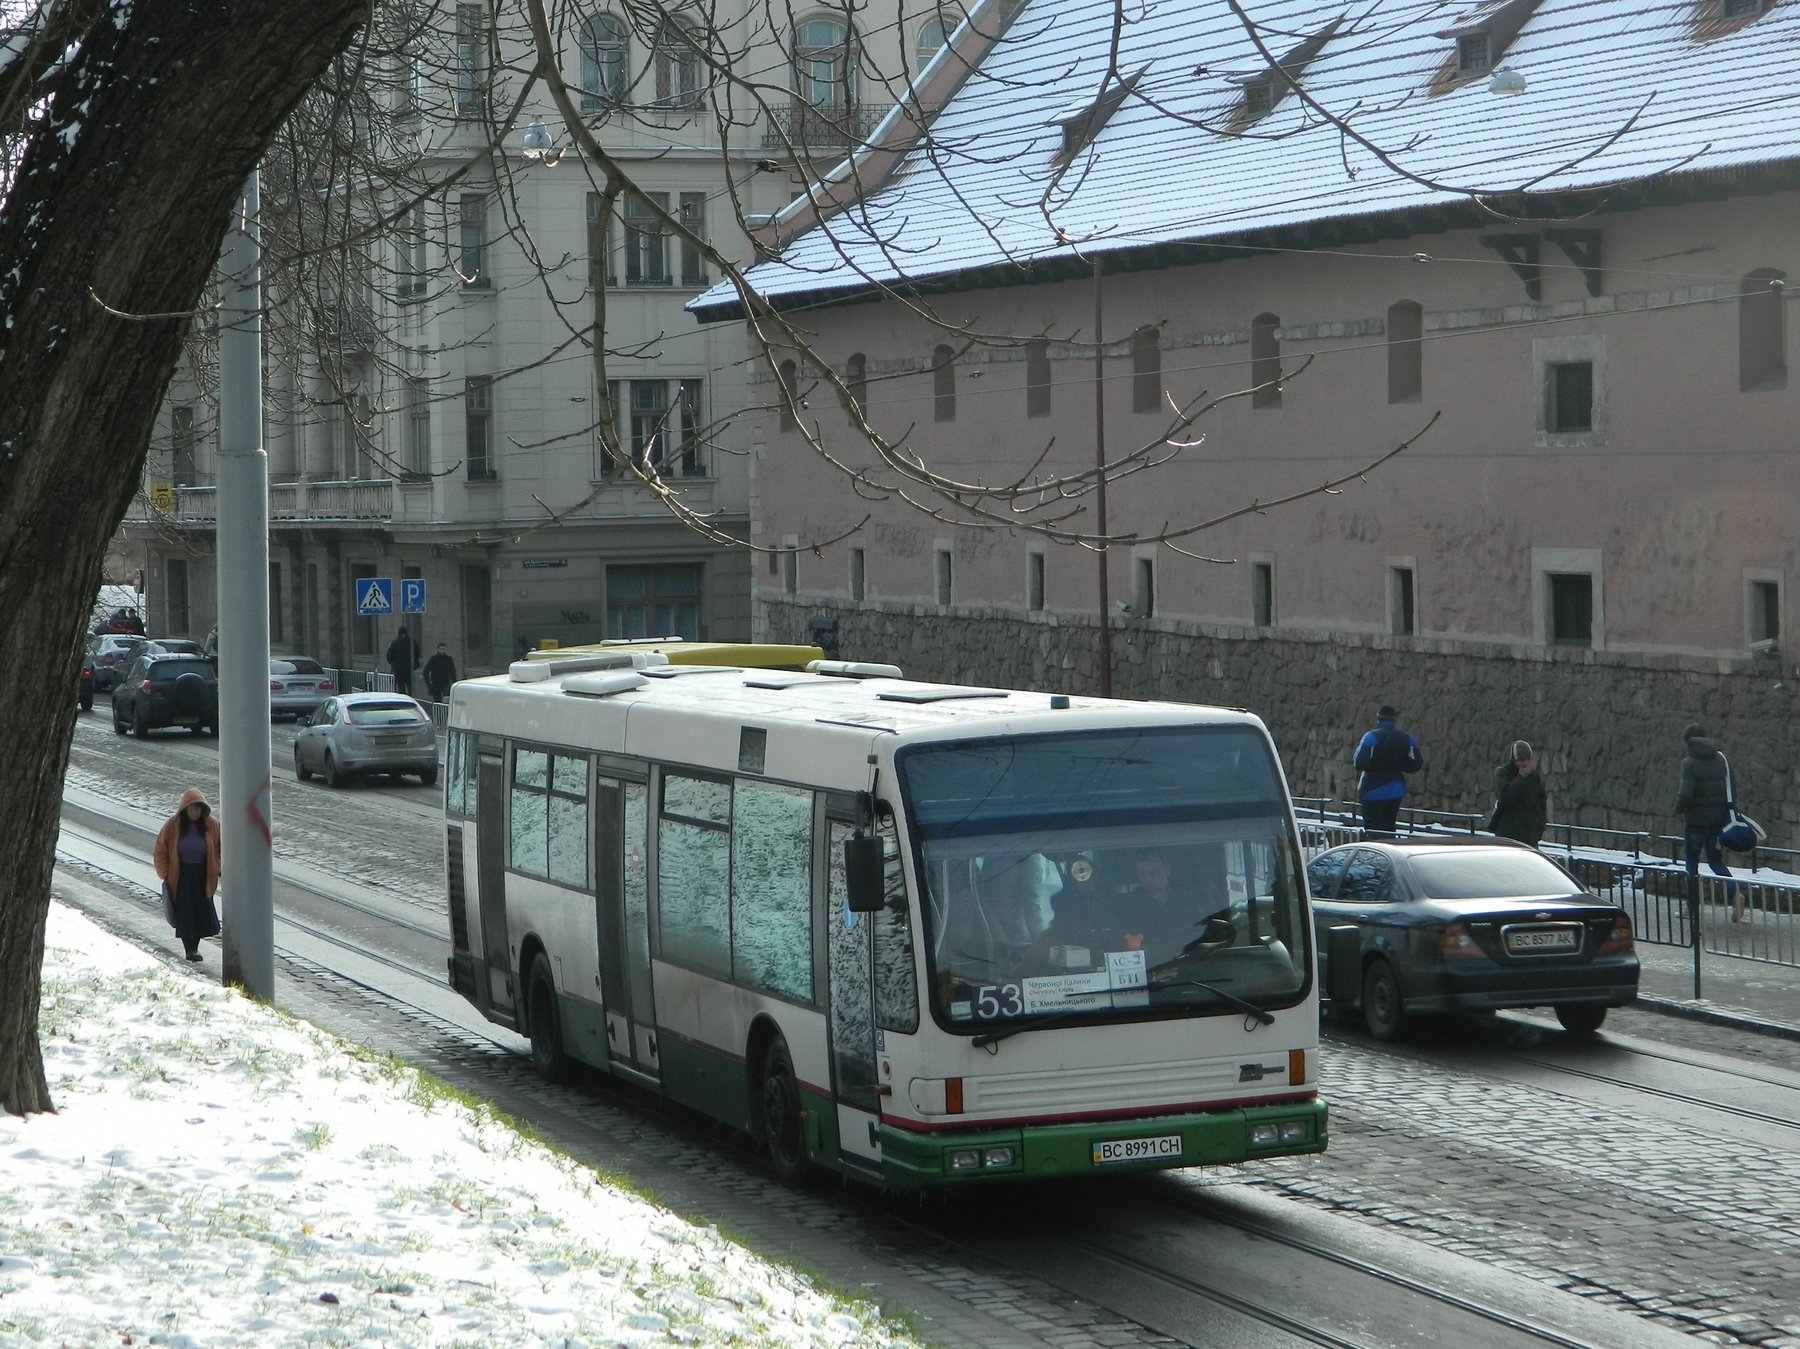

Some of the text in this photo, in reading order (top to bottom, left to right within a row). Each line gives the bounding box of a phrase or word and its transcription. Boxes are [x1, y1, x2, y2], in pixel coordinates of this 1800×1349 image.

[407, 584, 420, 604] P
[1516, 933, 1572, 946] BC 8577 AK
[1029, 978, 1091, 989] Червоної Калини
[978, 983, 1023, 1019] 53
[1030, 997, 1096, 1008] Б. Хмельницького
[1102, 1138, 1180, 1158] BC 8991 CH
